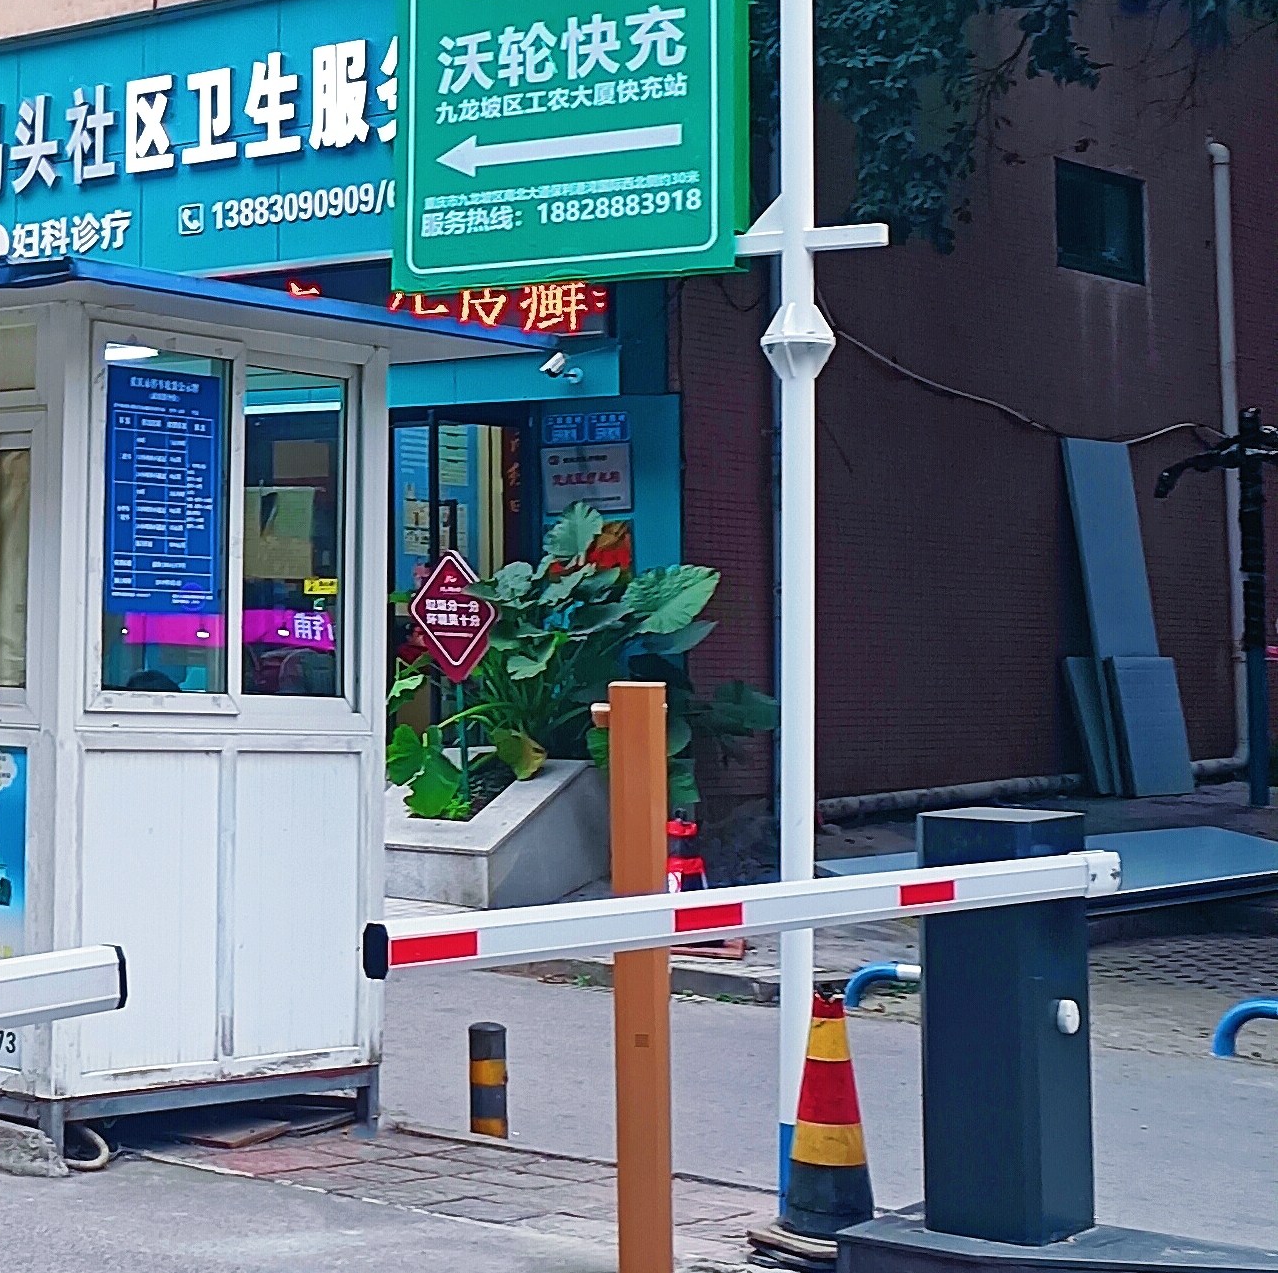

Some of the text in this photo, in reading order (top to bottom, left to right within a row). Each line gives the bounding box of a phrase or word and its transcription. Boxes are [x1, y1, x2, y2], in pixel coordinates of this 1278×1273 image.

[437, 5, 688, 95] 沃轮快充
[435, 72, 688, 124] 九龙坡区工农大厦快充站
[536, 188, 702, 224] 18828883918
[10, 210, 133, 258] 妇科诊疗
